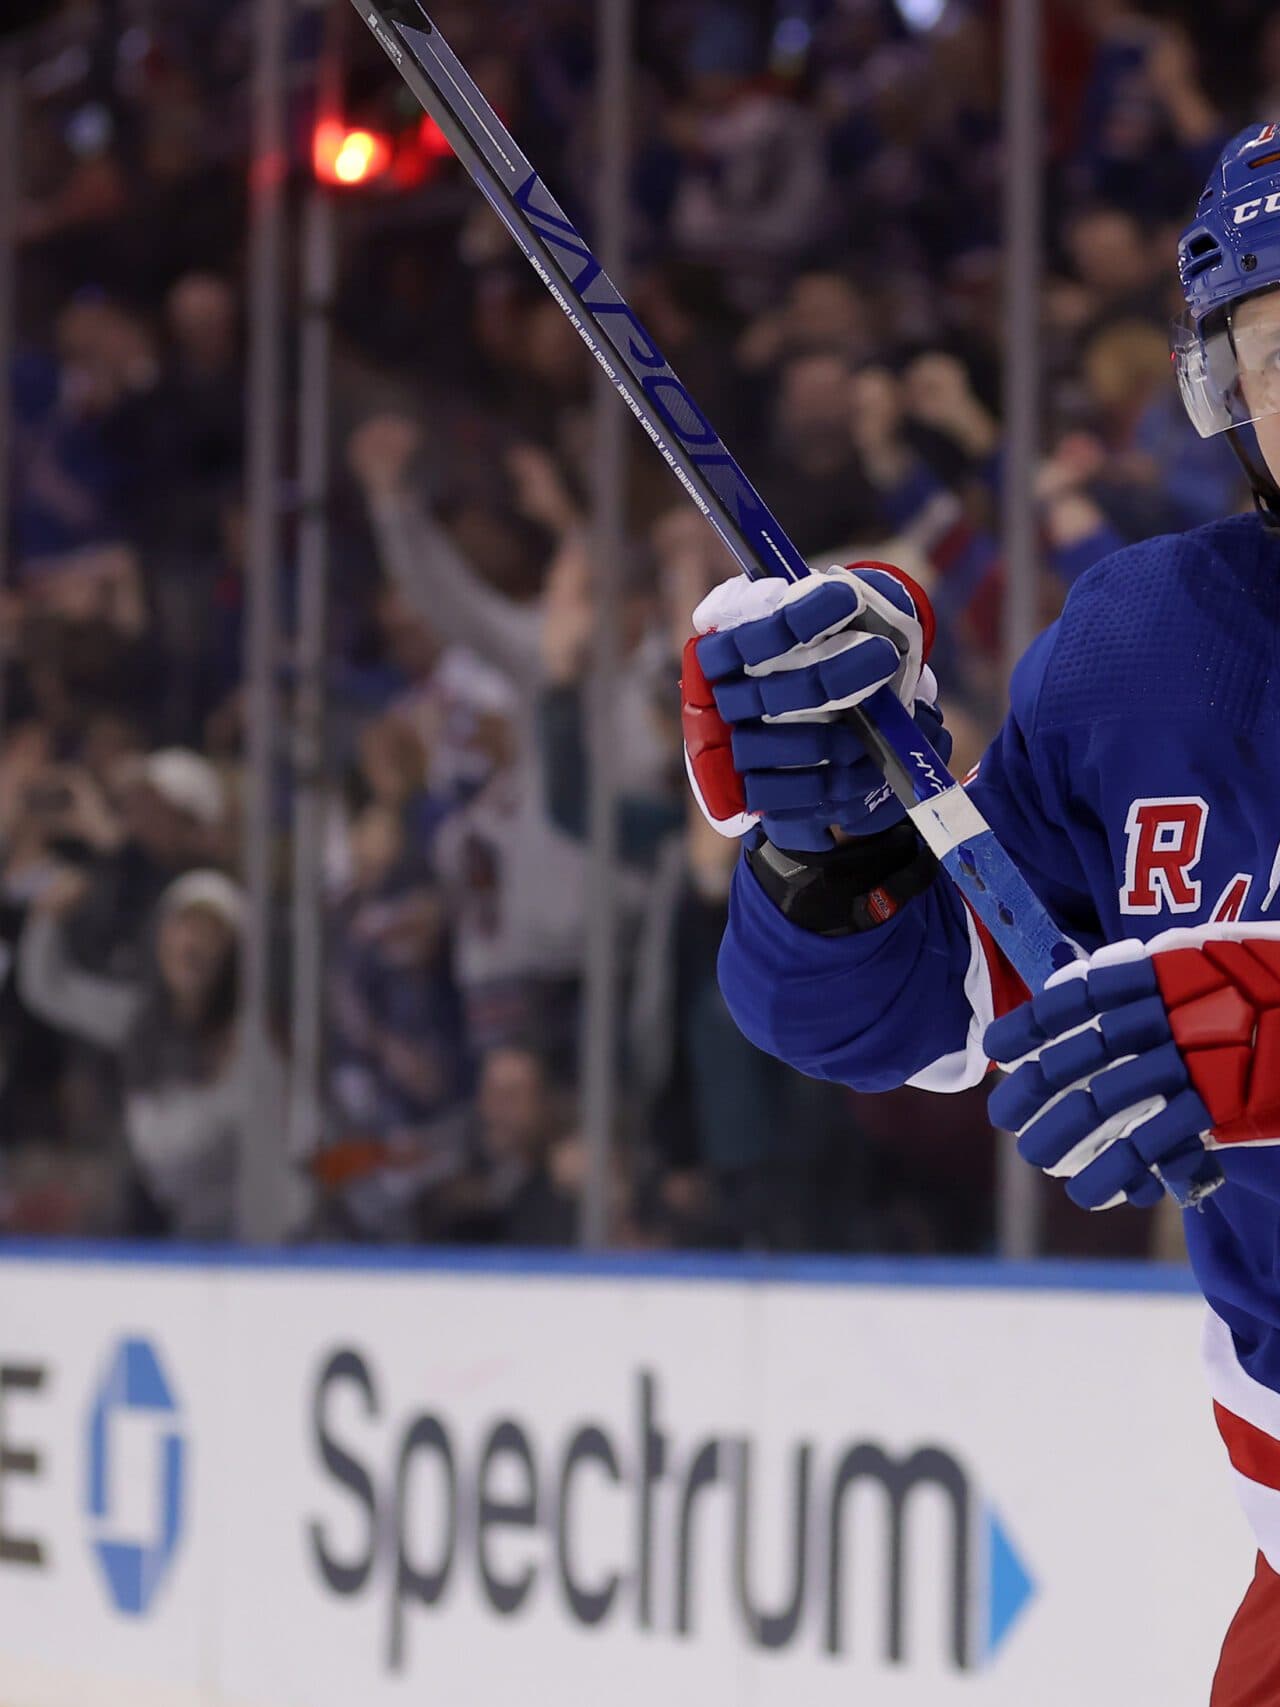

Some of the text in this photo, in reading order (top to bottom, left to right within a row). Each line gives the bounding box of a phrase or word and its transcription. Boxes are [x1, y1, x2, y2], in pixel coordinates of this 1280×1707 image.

[528, 254, 552, 284] RAPIDE
[547, 283, 572, 314] LANCER
[568, 313, 581, 329] UN
[577, 327, 597, 350] POUR
[616, 382, 643, 417] RELEASE
[639, 416, 660, 442] QUICK
[661, 448, 677, 466] FOR
[673, 464, 710, 515] ENGINEERED
[309, 1346, 971, 1674] Spectrum
